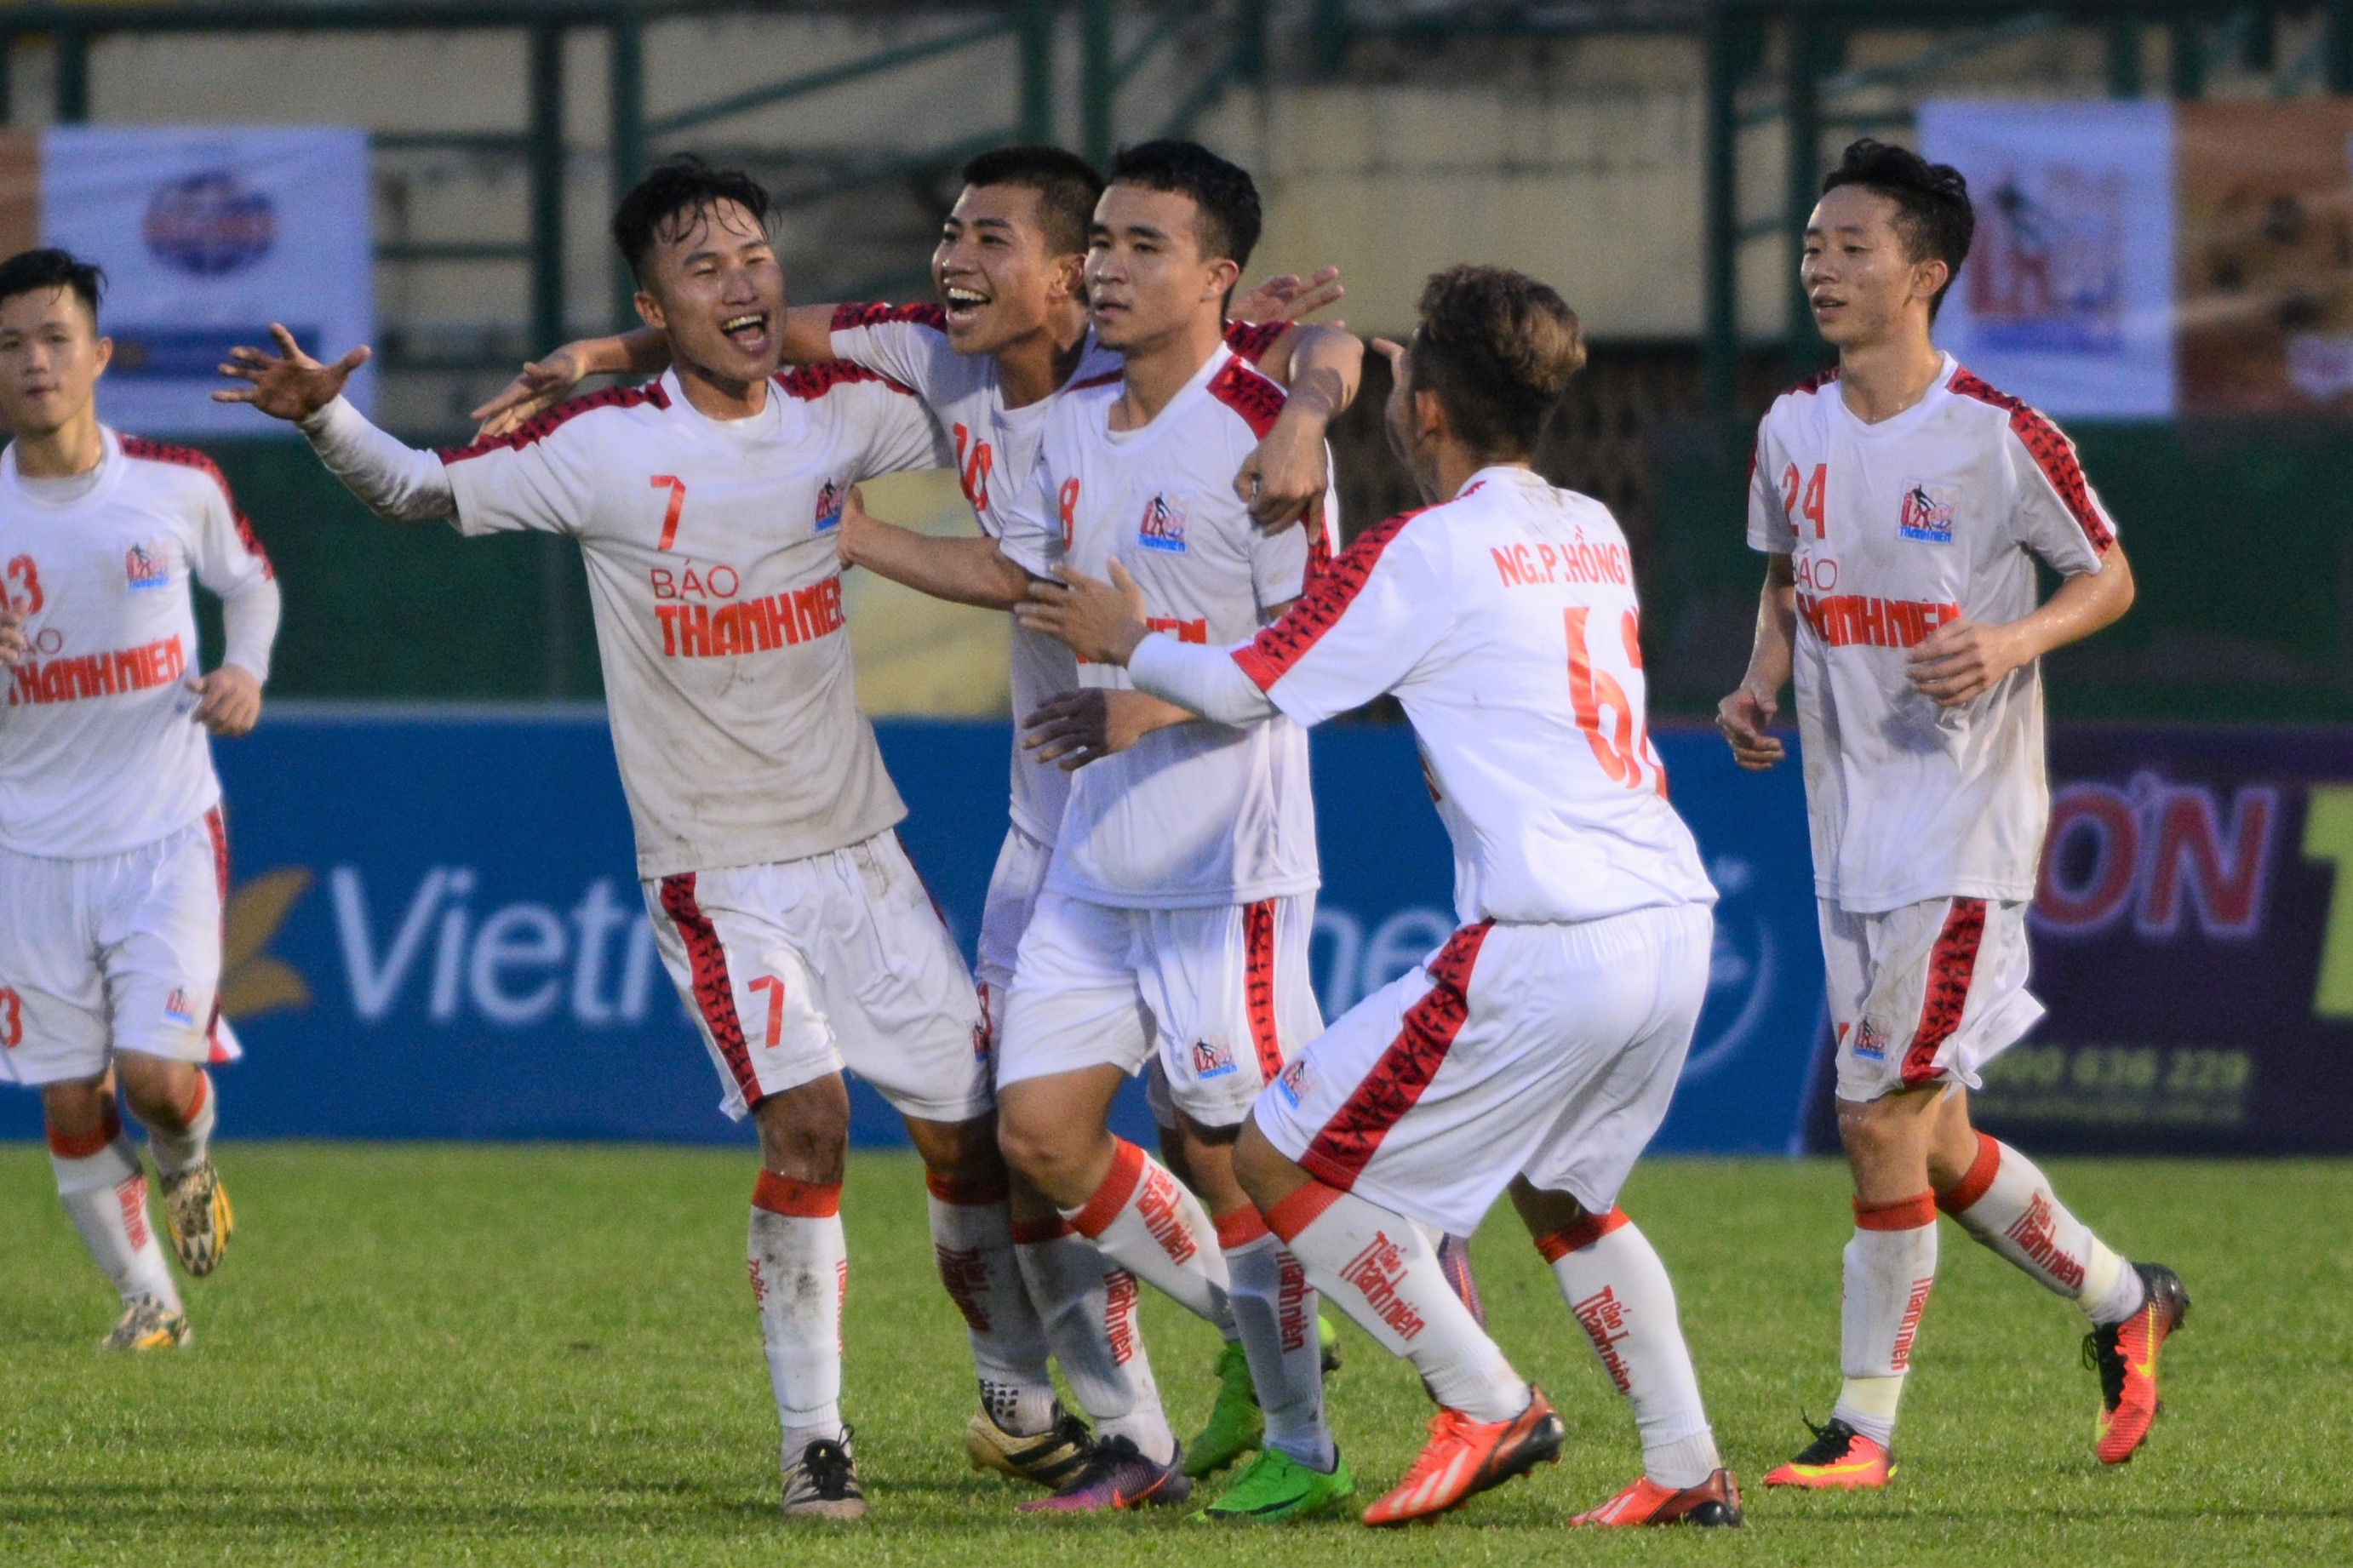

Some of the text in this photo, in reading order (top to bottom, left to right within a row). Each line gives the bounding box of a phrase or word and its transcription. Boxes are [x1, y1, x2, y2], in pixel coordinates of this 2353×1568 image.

[650, 475, 686, 552] 7
[1782, 462, 1827, 540] 24
[0, 554, 44, 615] 3
[747, 974, 784, 1049] 7
